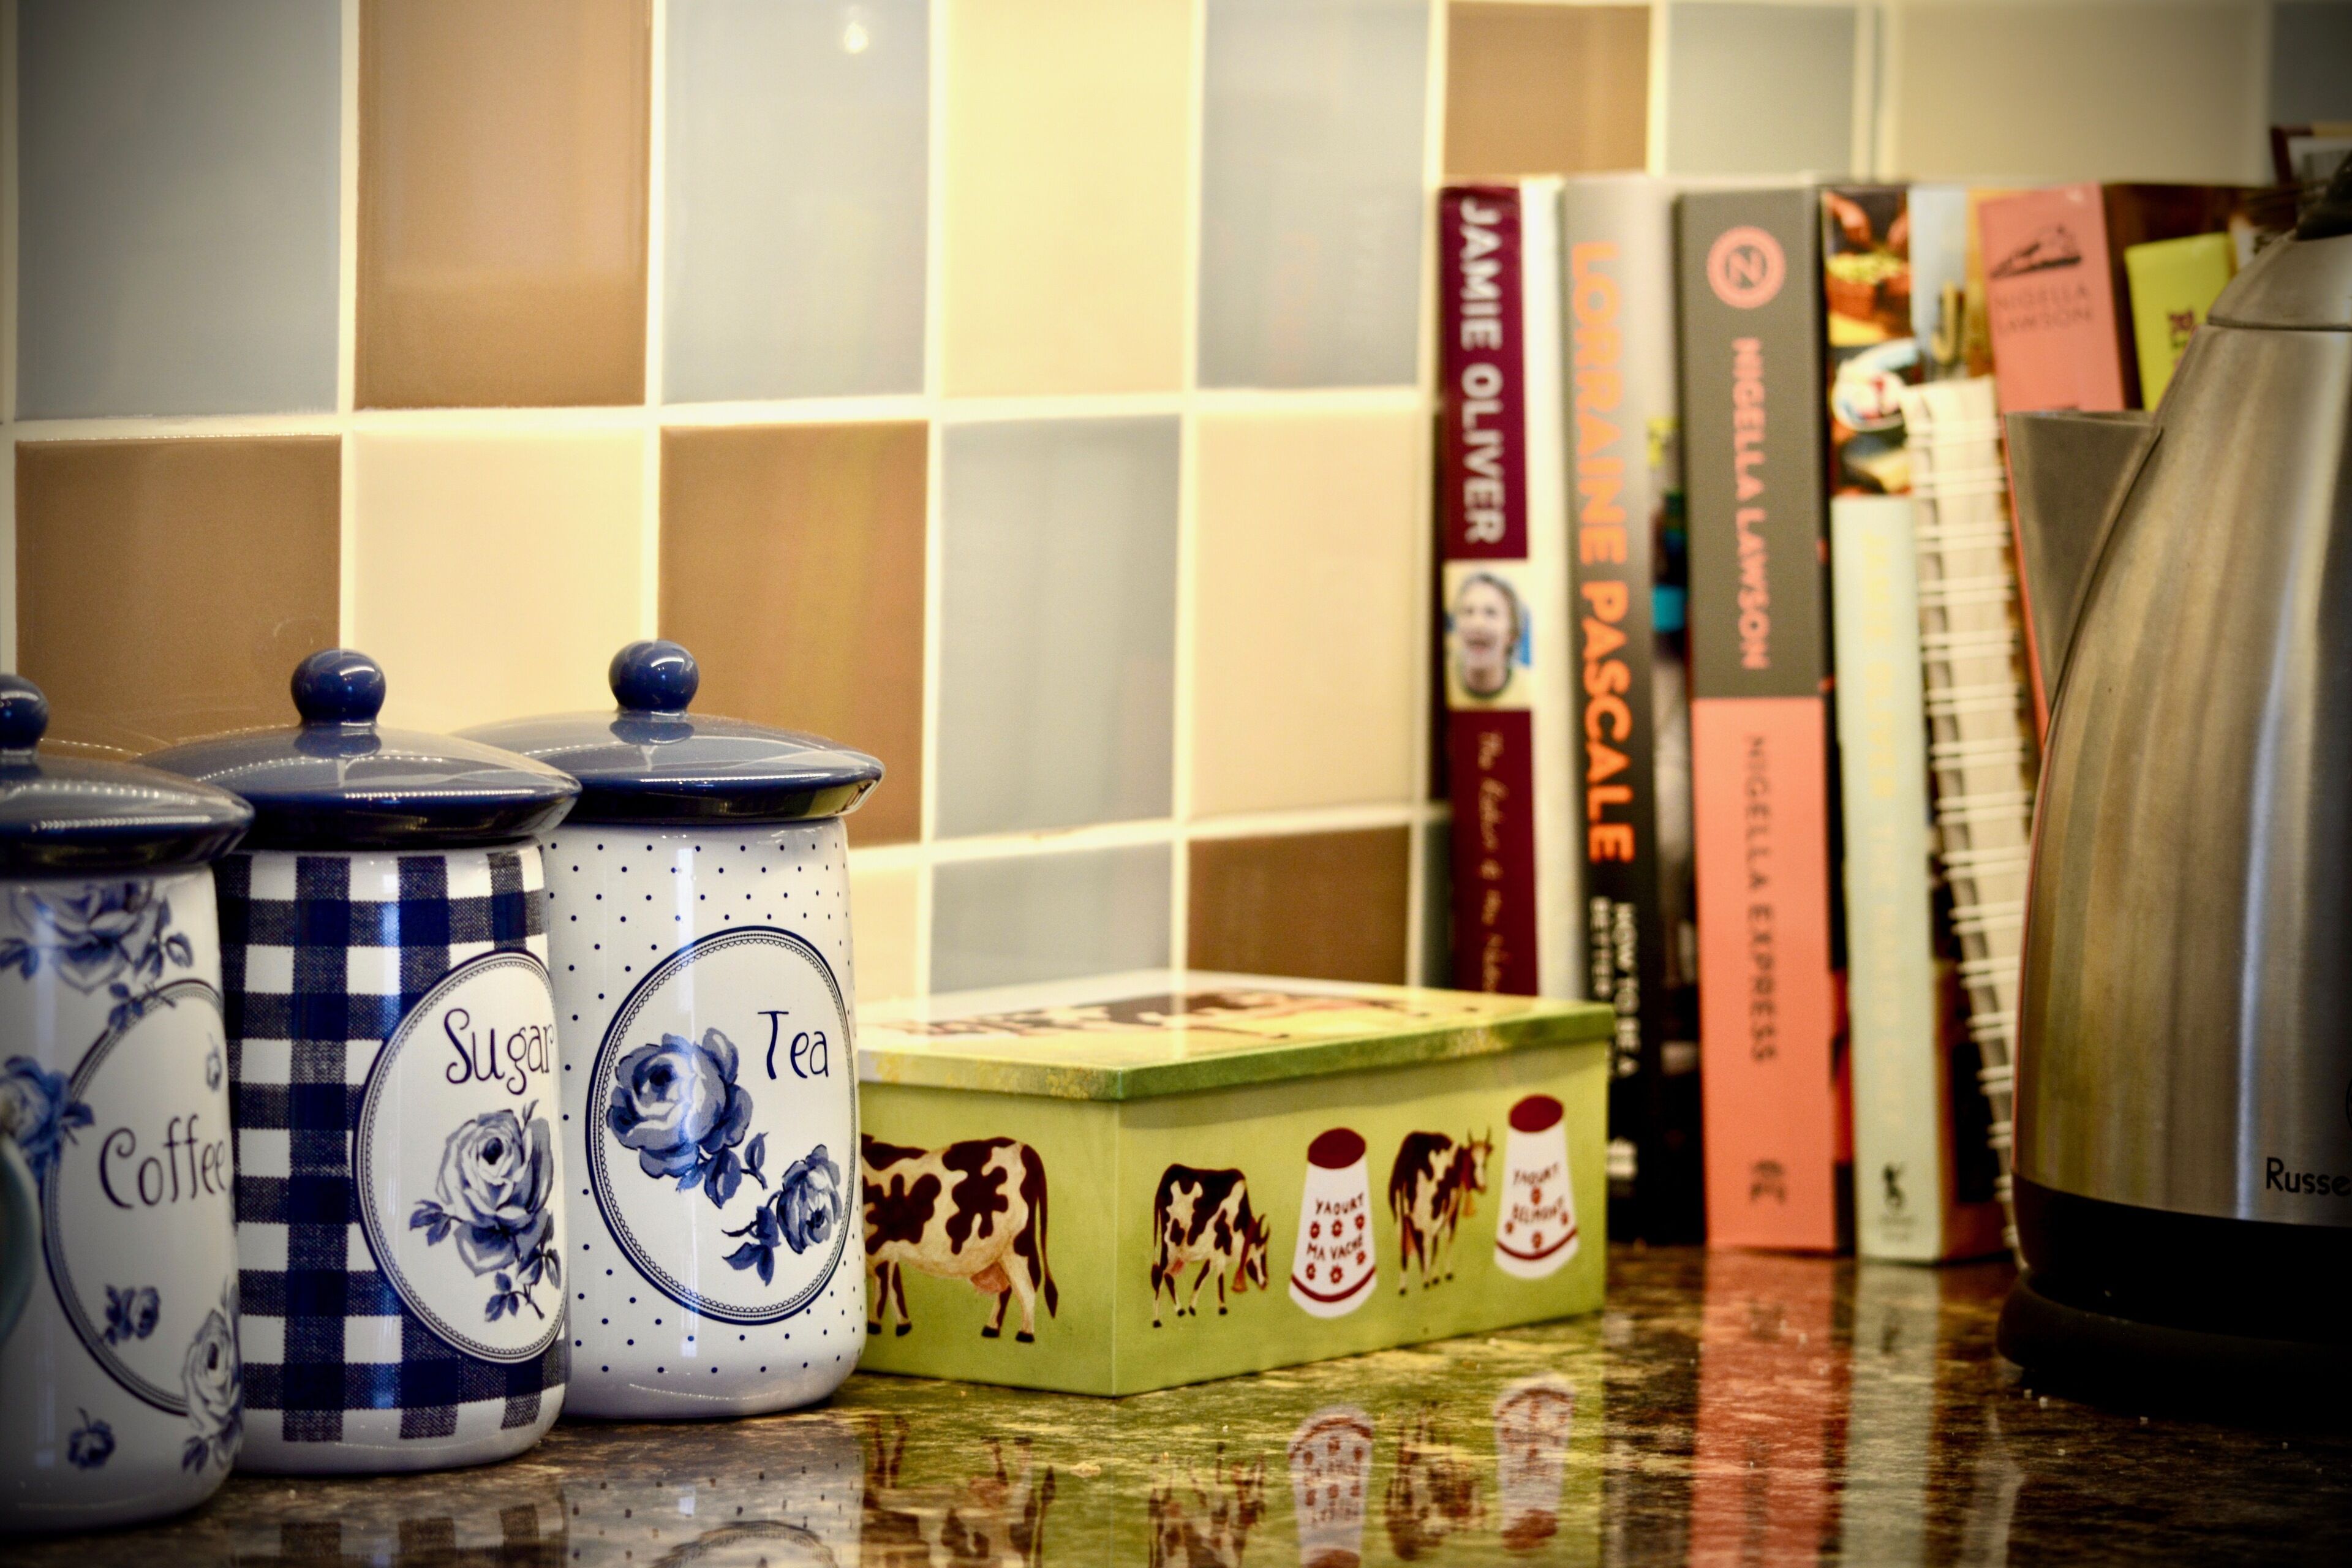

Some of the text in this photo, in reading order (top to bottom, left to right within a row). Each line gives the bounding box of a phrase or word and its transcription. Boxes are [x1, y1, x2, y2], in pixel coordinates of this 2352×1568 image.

[1460, 197, 1506, 544] JAMIE OLIVER
[1733, 337, 1770, 670] NIGELLA LAWSON
[1571, 242, 1635, 864] LORRAINE PASCALE
[1613, 903, 1637, 971] HOW
[1746, 735, 1778, 1063] NIGELLA EXPRESS
[444, 1008, 554, 1095] Sugar
[758, 1011, 829, 1080] Tea
[99, 1113, 226, 1210] Coffee
[1316, 1192, 1364, 1215] YAOURT
[2266, 1156, 2351, 1196] Russe
[1306, 1234, 1362, 1261] MA VACHE
